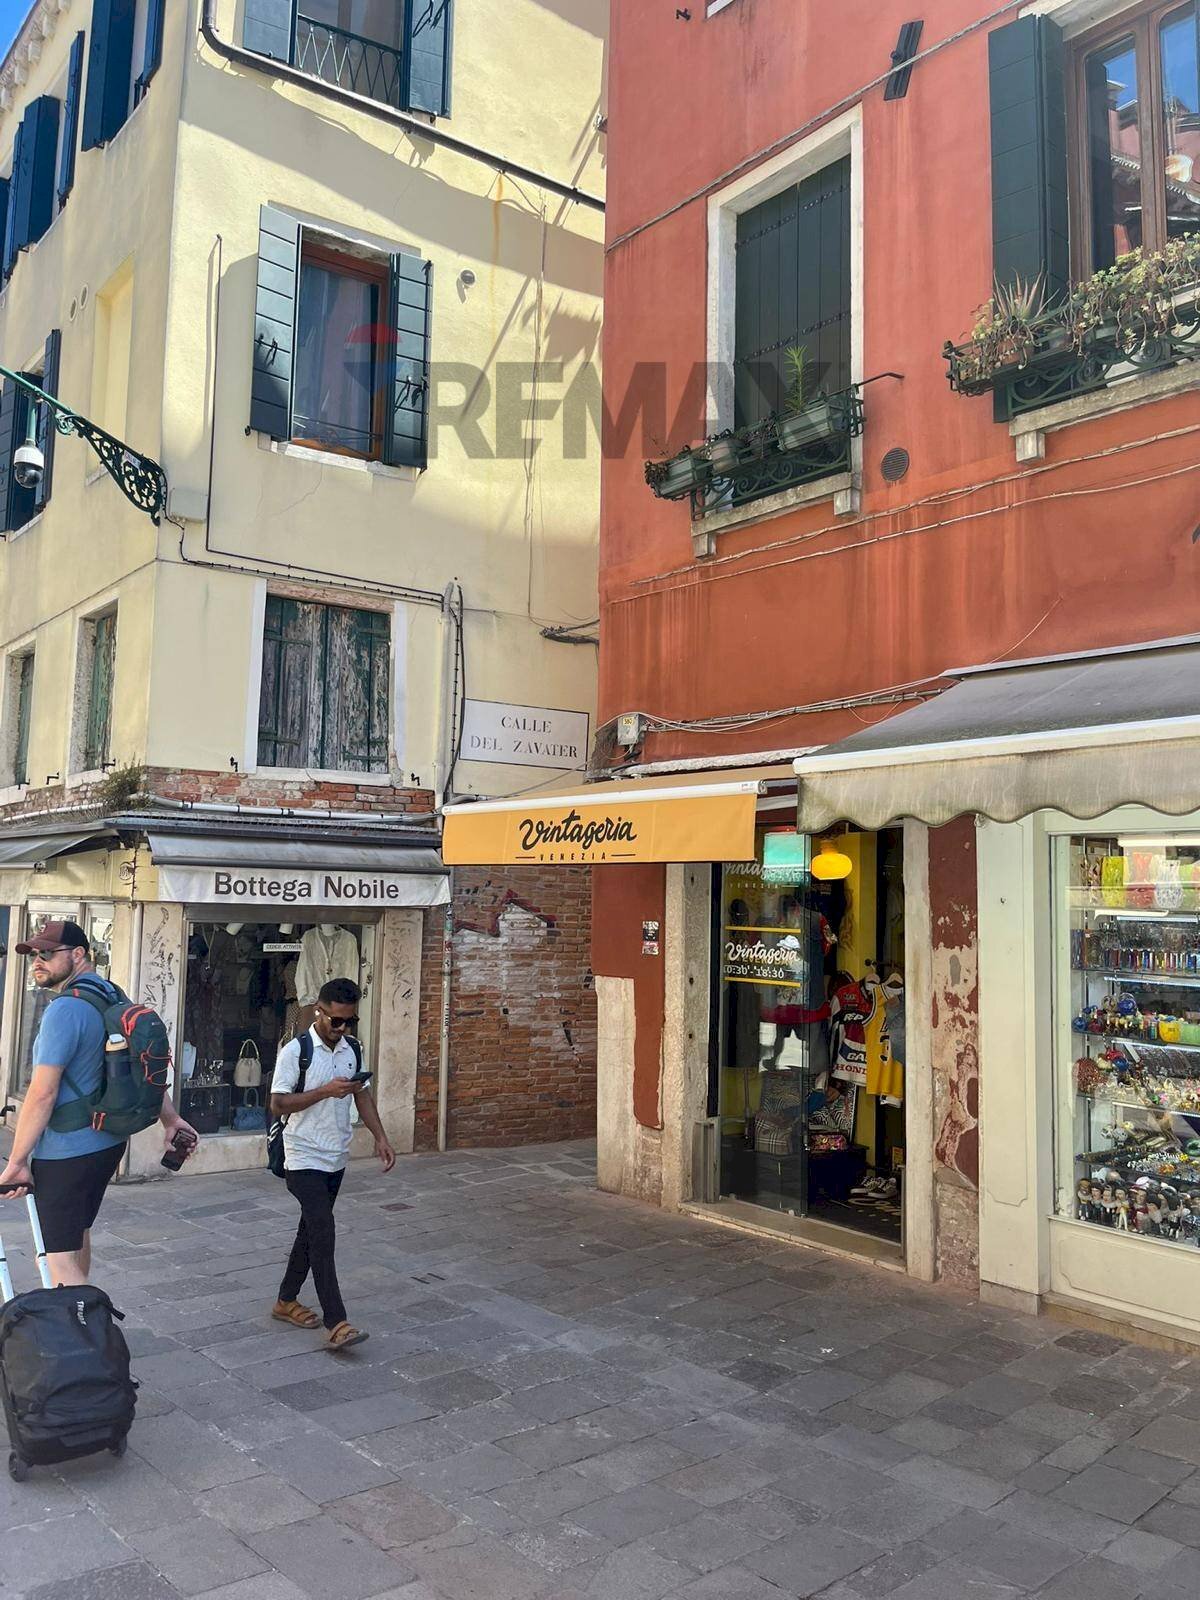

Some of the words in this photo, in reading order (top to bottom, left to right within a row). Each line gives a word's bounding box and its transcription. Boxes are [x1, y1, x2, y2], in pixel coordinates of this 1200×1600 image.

[501, 715, 552, 734] CALLE
[470, 735, 503, 752] DEL
[513, 740, 577, 759] ZAVATER
[519, 809, 637, 851] Vintageria
[540, 852, 607, 862] VENEZIA
[214, 871, 312, 902] Bottega
[324, 876, 400, 900] Nobile
[725, 940, 800, 963] Vintageria
[755, 968, 785, 979] 18:30
